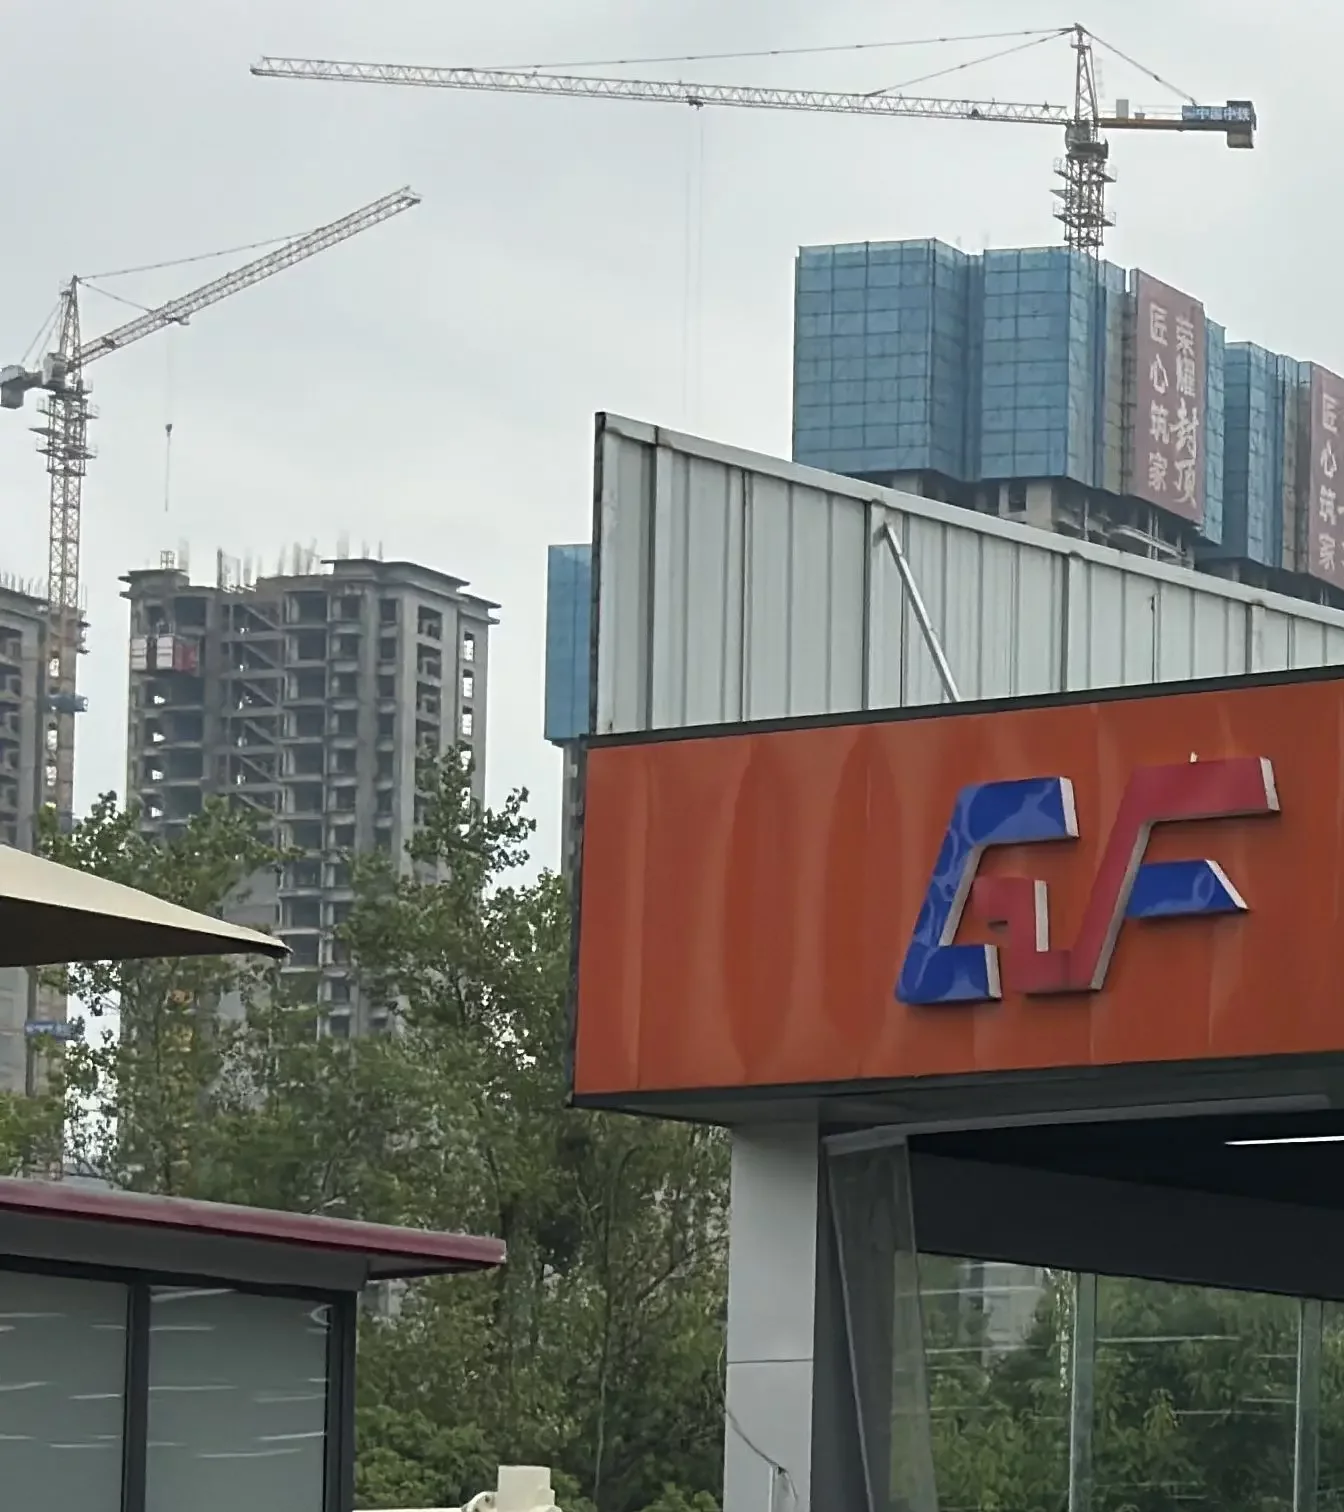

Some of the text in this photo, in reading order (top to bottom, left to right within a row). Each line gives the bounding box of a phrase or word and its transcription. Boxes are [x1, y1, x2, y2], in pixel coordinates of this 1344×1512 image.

[1149, 303, 1170, 491] 匠心筑家
[1169, 315, 1199, 508] 荣耀封顶
